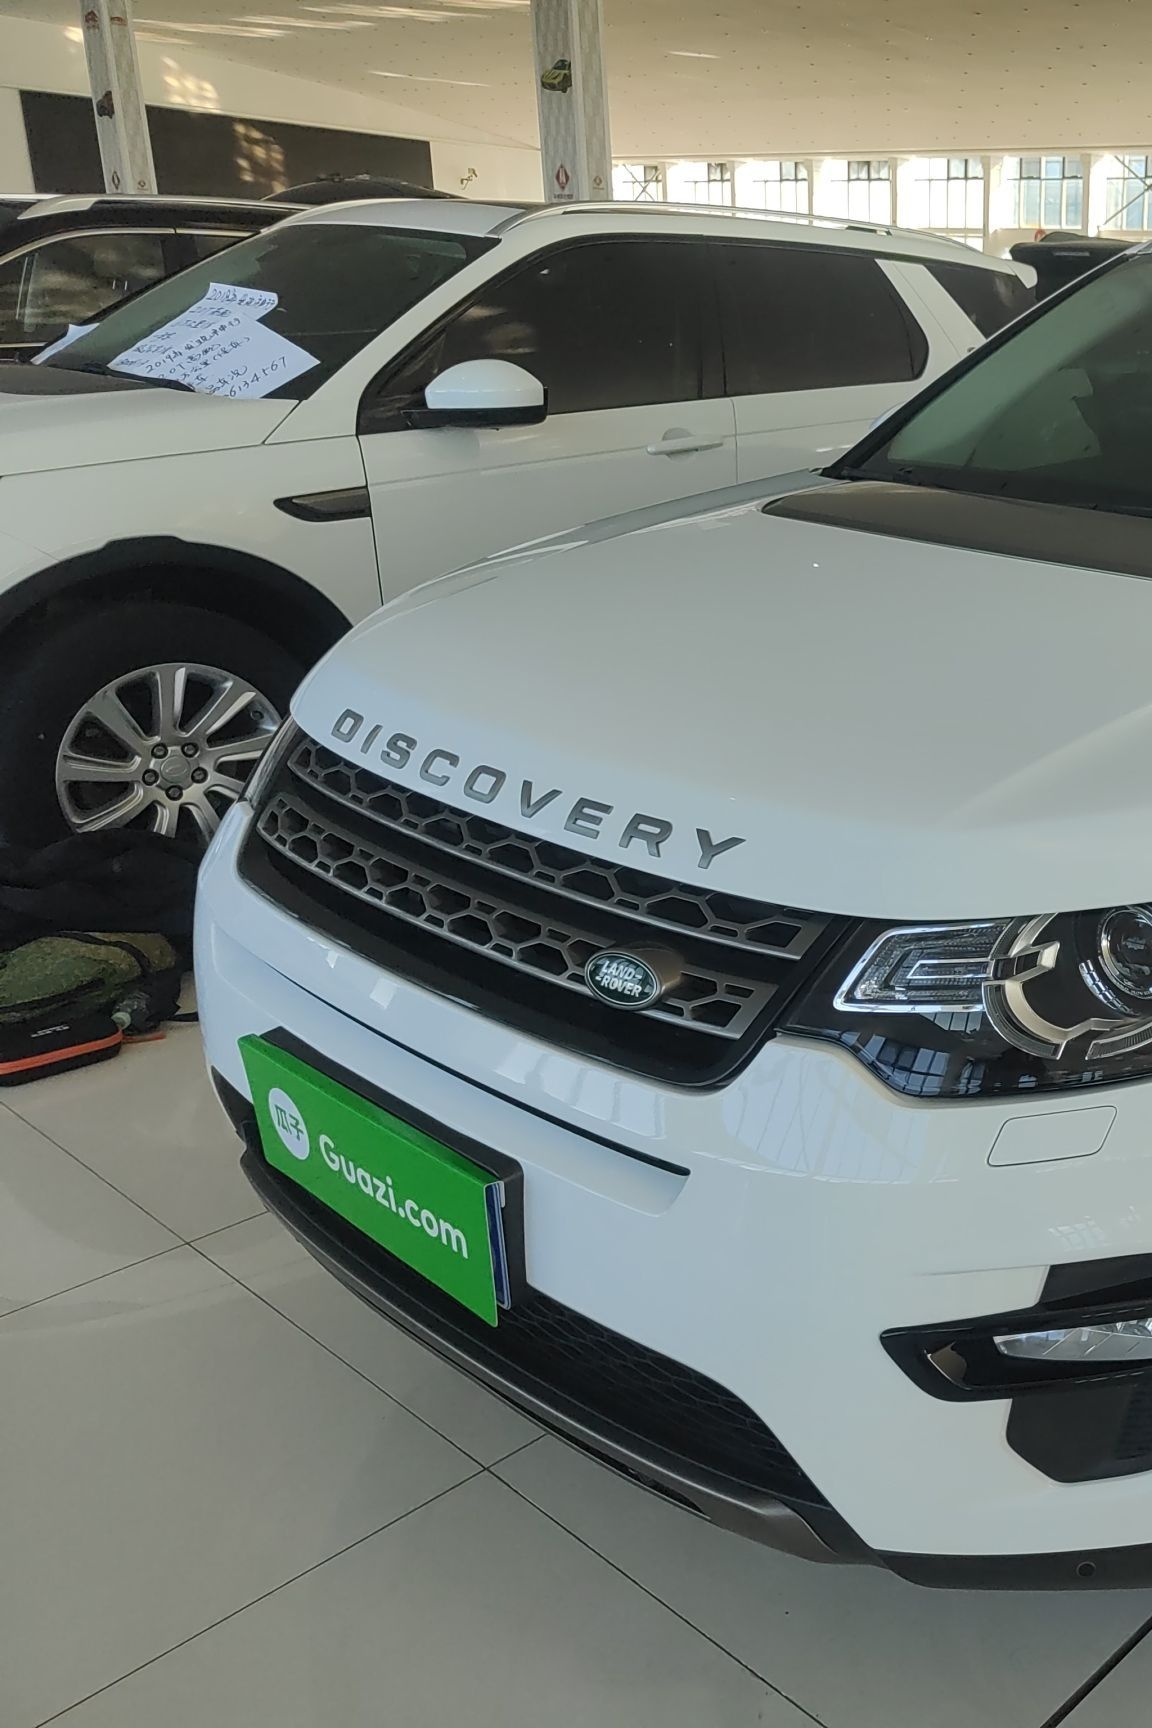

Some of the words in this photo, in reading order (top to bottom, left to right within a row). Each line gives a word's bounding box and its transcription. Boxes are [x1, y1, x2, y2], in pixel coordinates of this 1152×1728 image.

[330, 708, 747, 870] DISCOVERY
[274, 1104, 304, 1140] 瓜子
[319, 1134, 468, 1259] Guazi.com
